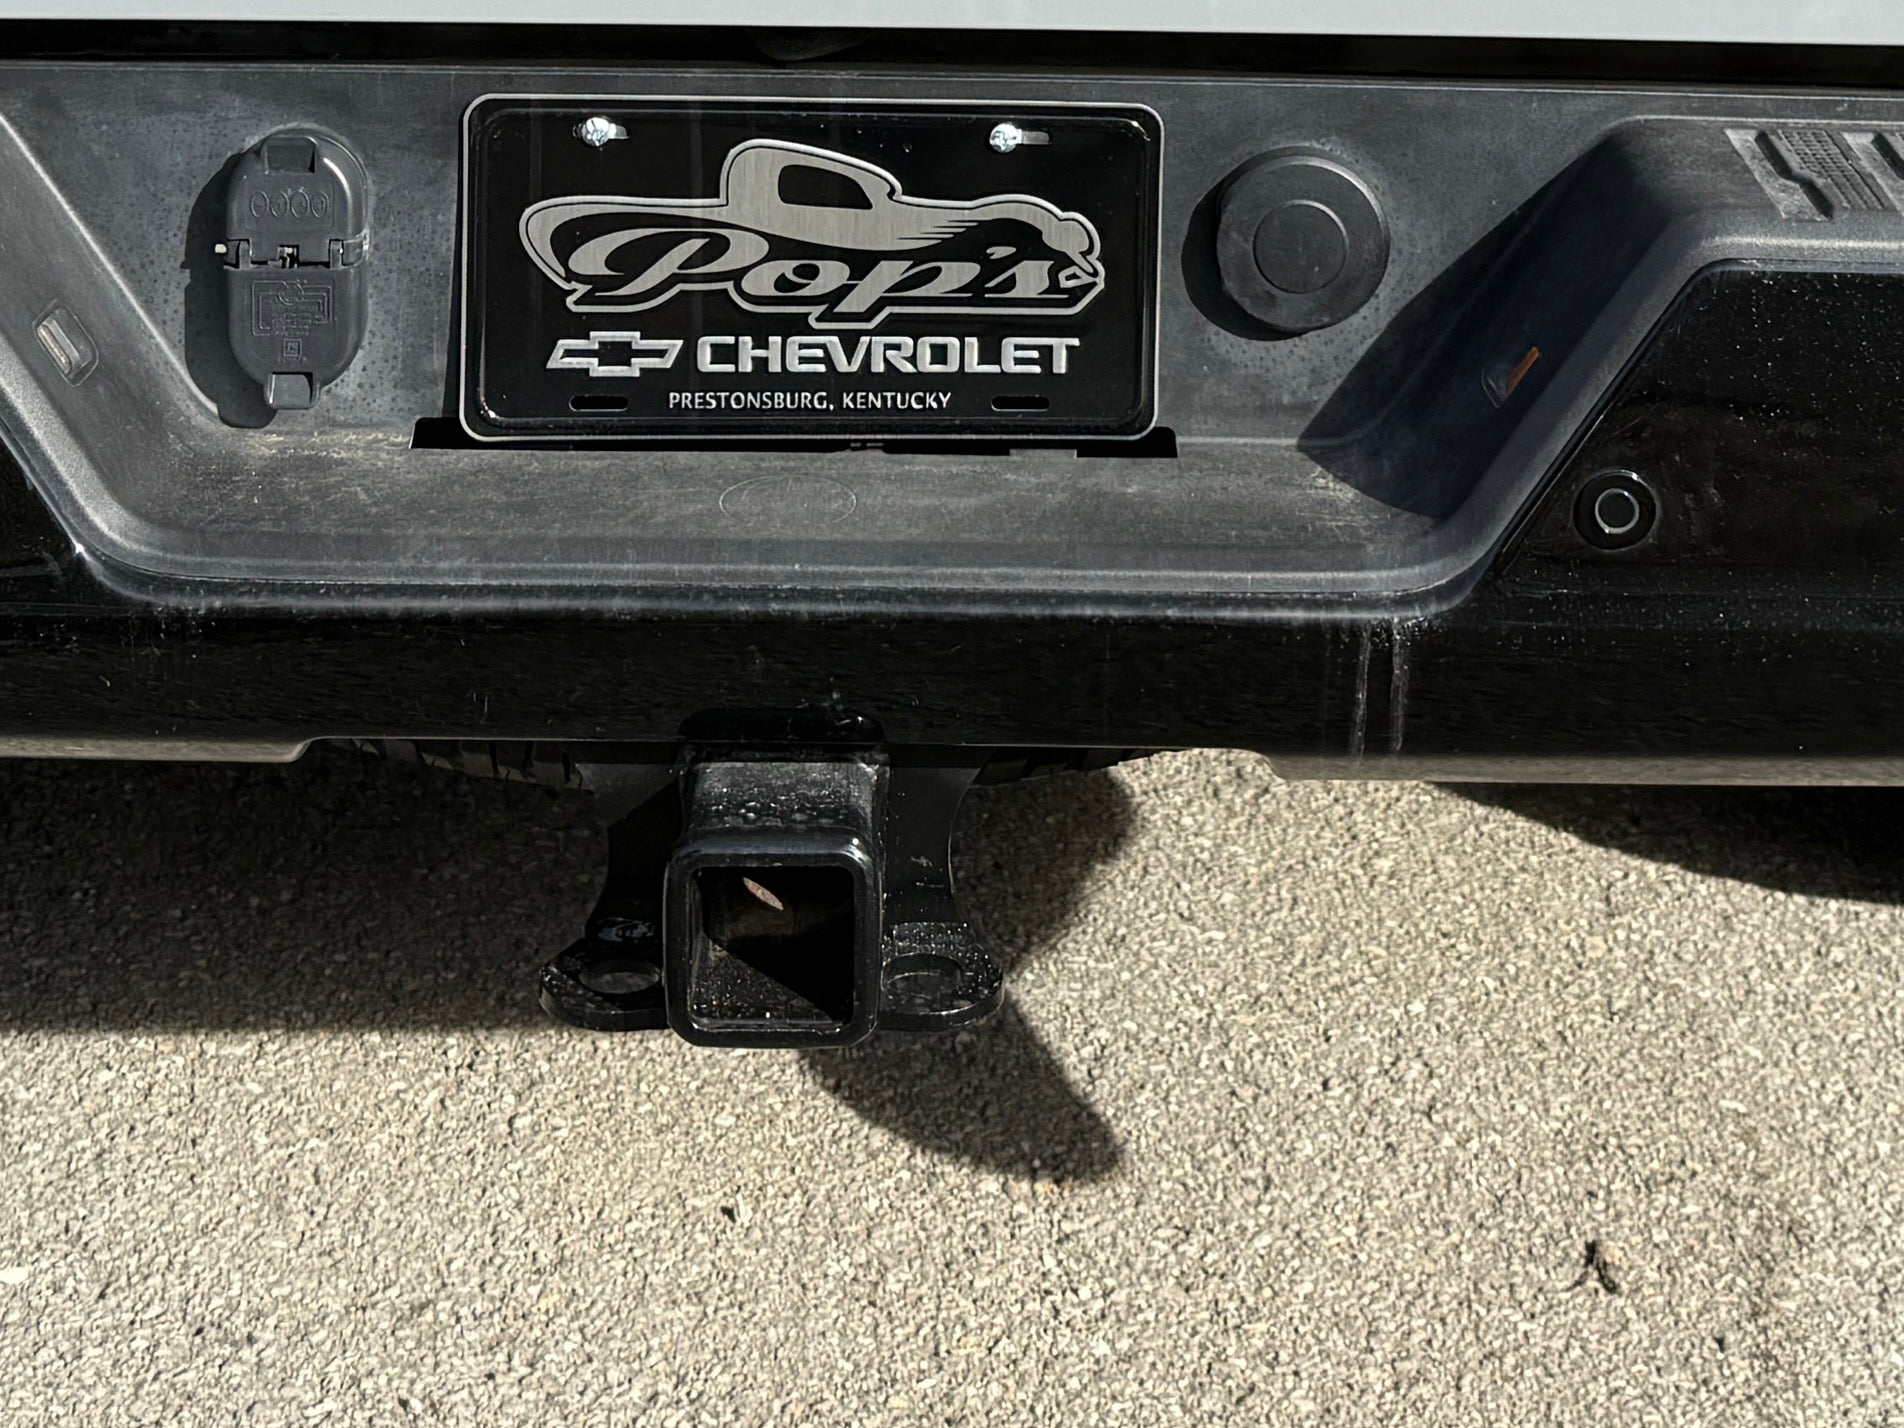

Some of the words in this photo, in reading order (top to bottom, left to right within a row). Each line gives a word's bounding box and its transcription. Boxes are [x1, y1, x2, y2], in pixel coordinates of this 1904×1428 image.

[568, 227, 1071, 313] Pop's
[697, 335, 1081, 374] CHEVROLET
[668, 391, 835, 412] PRESTONSBURG,
[842, 391, 952, 411] KENTUCKY
